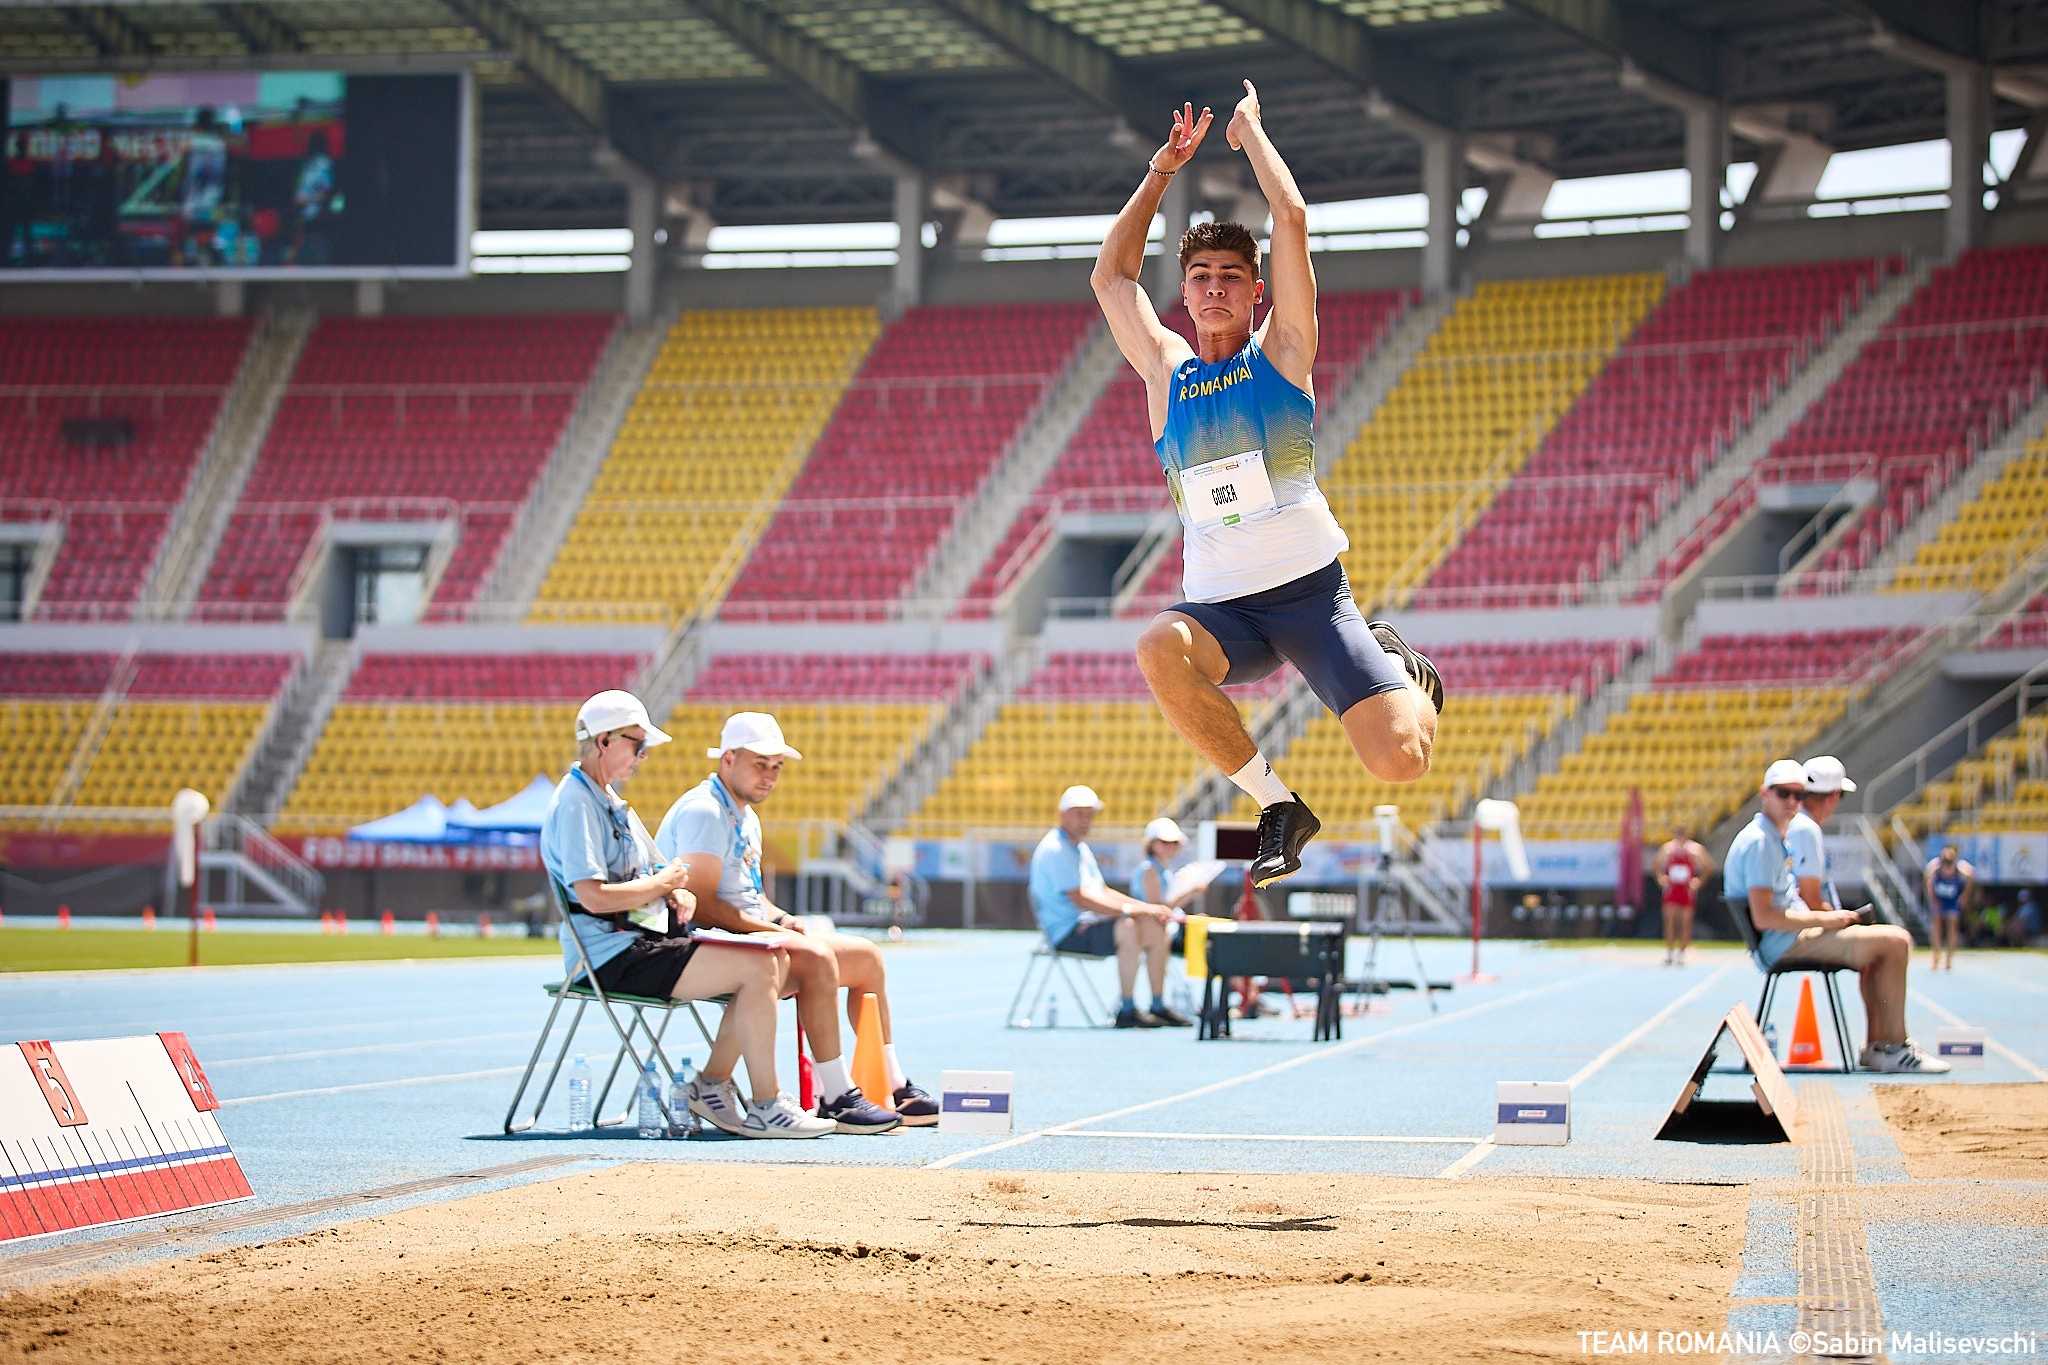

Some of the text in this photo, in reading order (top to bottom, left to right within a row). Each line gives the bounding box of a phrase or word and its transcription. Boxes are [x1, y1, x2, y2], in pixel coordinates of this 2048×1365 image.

[1179, 366, 1250, 402] ROMANIA
[36, 1057, 76, 1121] 5
[182, 1048, 212, 1105] 4
